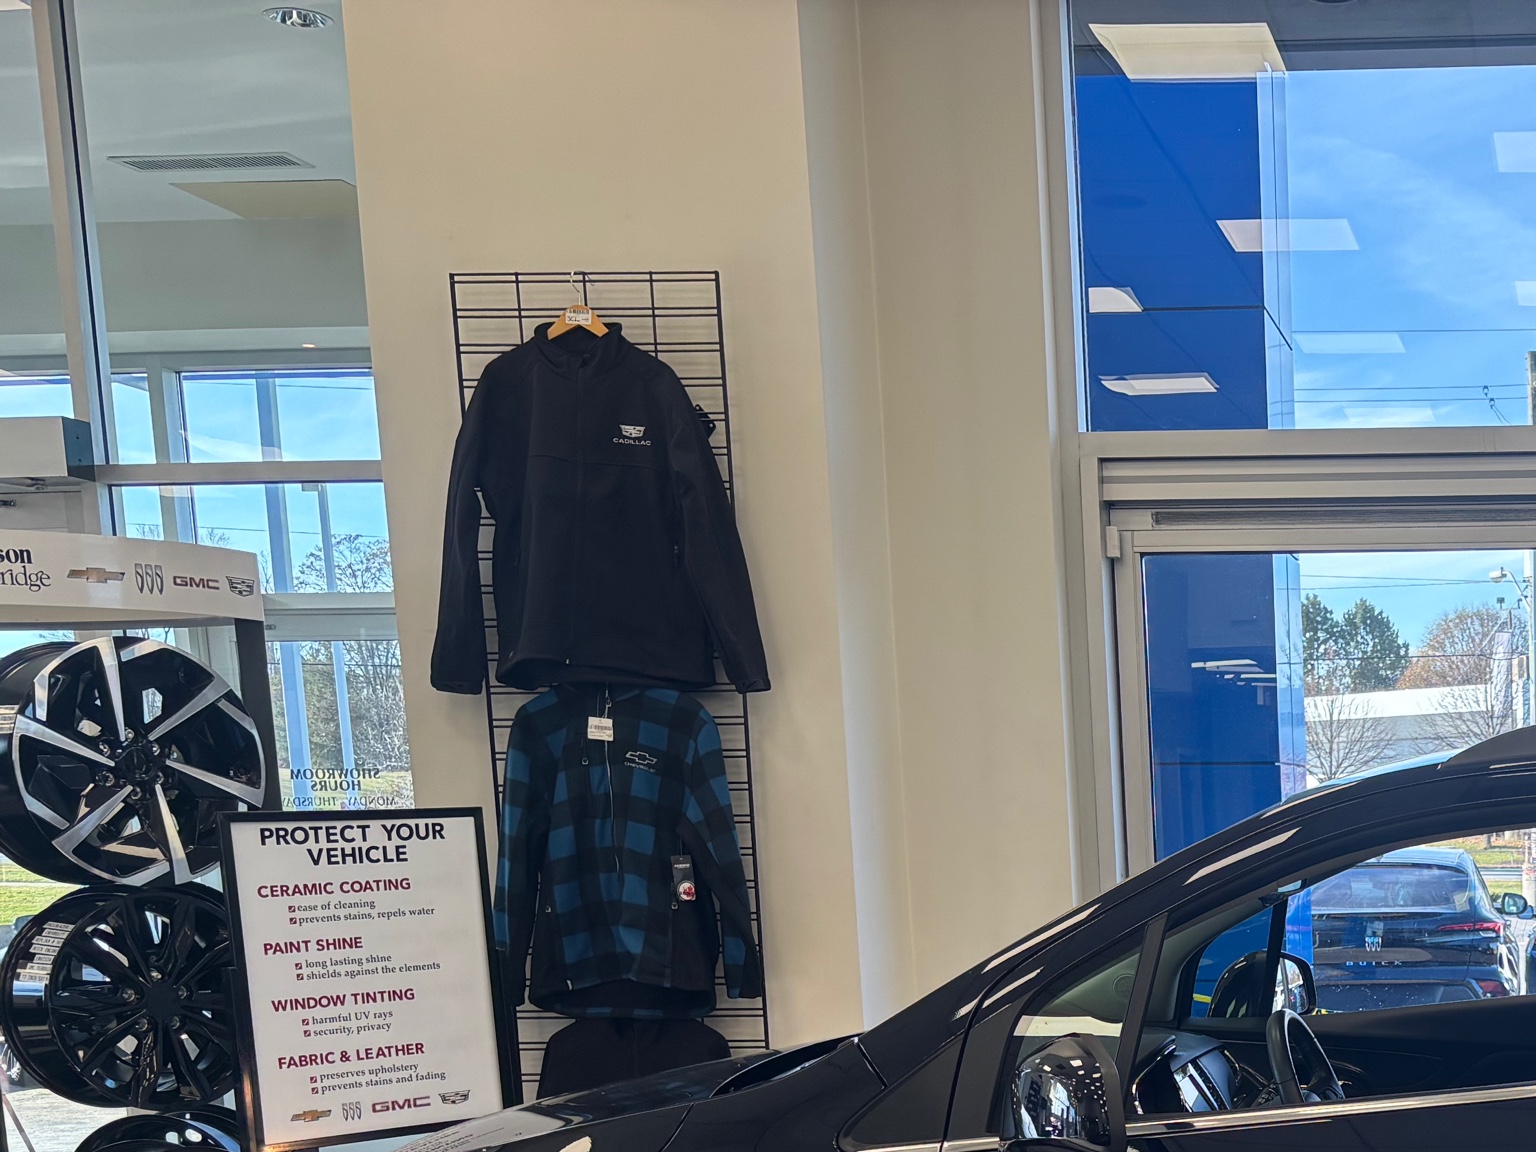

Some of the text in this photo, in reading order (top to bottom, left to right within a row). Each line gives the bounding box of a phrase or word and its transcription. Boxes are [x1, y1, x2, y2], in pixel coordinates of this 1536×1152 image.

[613, 437, 651, 446] CADILLAC
[172, 575, 220, 591] GMC
[260, 822, 446, 846] PROTECT YOUR
[306, 844, 408, 866] VEHICLE
[257, 877, 411, 898] CERAMIC COATING
[297, 899, 376, 912] ease of cleaning
[298, 907, 435, 926] prevents stains, repels water
[263, 936, 364, 955] PAINT SHINE
[305, 954, 392, 970] long lasting shine
[306, 962, 441, 980] shields against the elements
[271, 988, 415, 1012] WINDOW TINTING
[312, 1010, 393, 1025] harmful UV rays
[313, 1021, 392, 1037] security, privacy
[277, 1042, 425, 1069] FABRIC & LEATHER
[319, 1062, 419, 1083] preserves upholstery
[321, 1069, 447, 1095] prevents stains and fading
[371, 1096, 432, 1113] GMC
